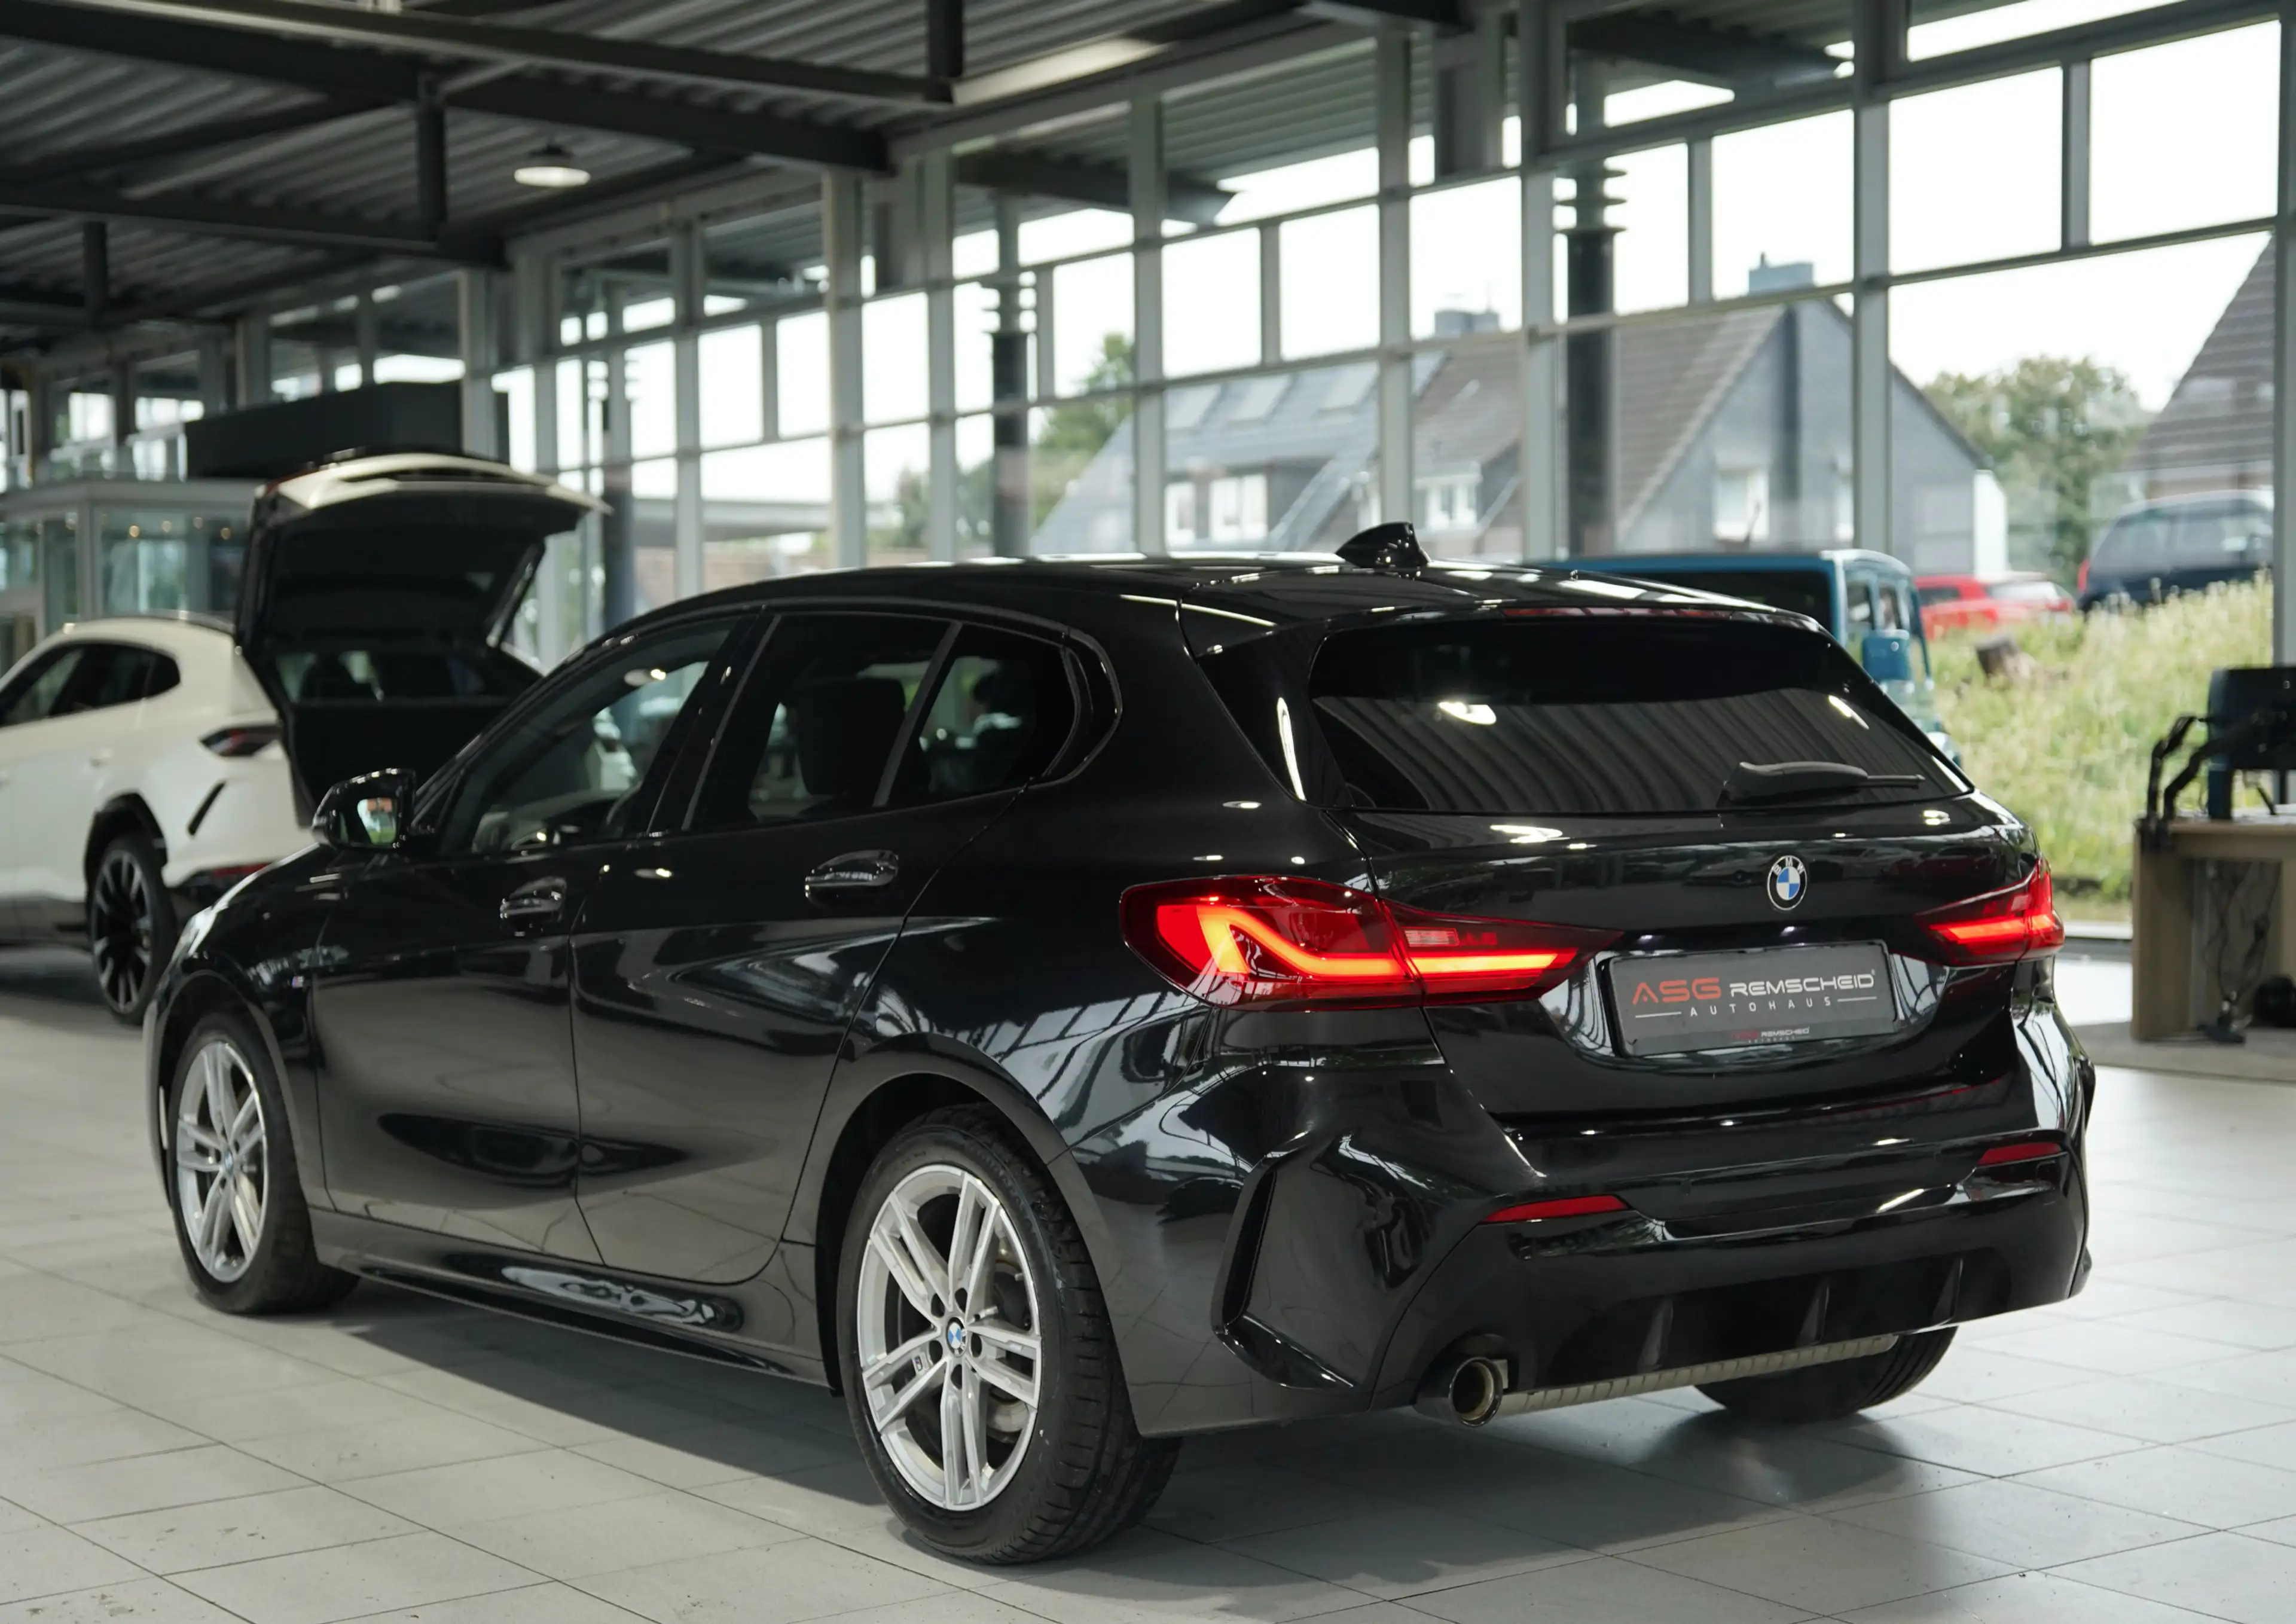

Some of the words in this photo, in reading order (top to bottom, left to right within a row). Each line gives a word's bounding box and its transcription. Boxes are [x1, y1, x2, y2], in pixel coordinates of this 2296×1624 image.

[1772, 855, 1805, 876] BMW
[1632, 977, 1722, 1005] ASG
[1729, 973, 1874, 997] REMSCHEID
[1690, 996, 1831, 1017] AUTOHAUS
